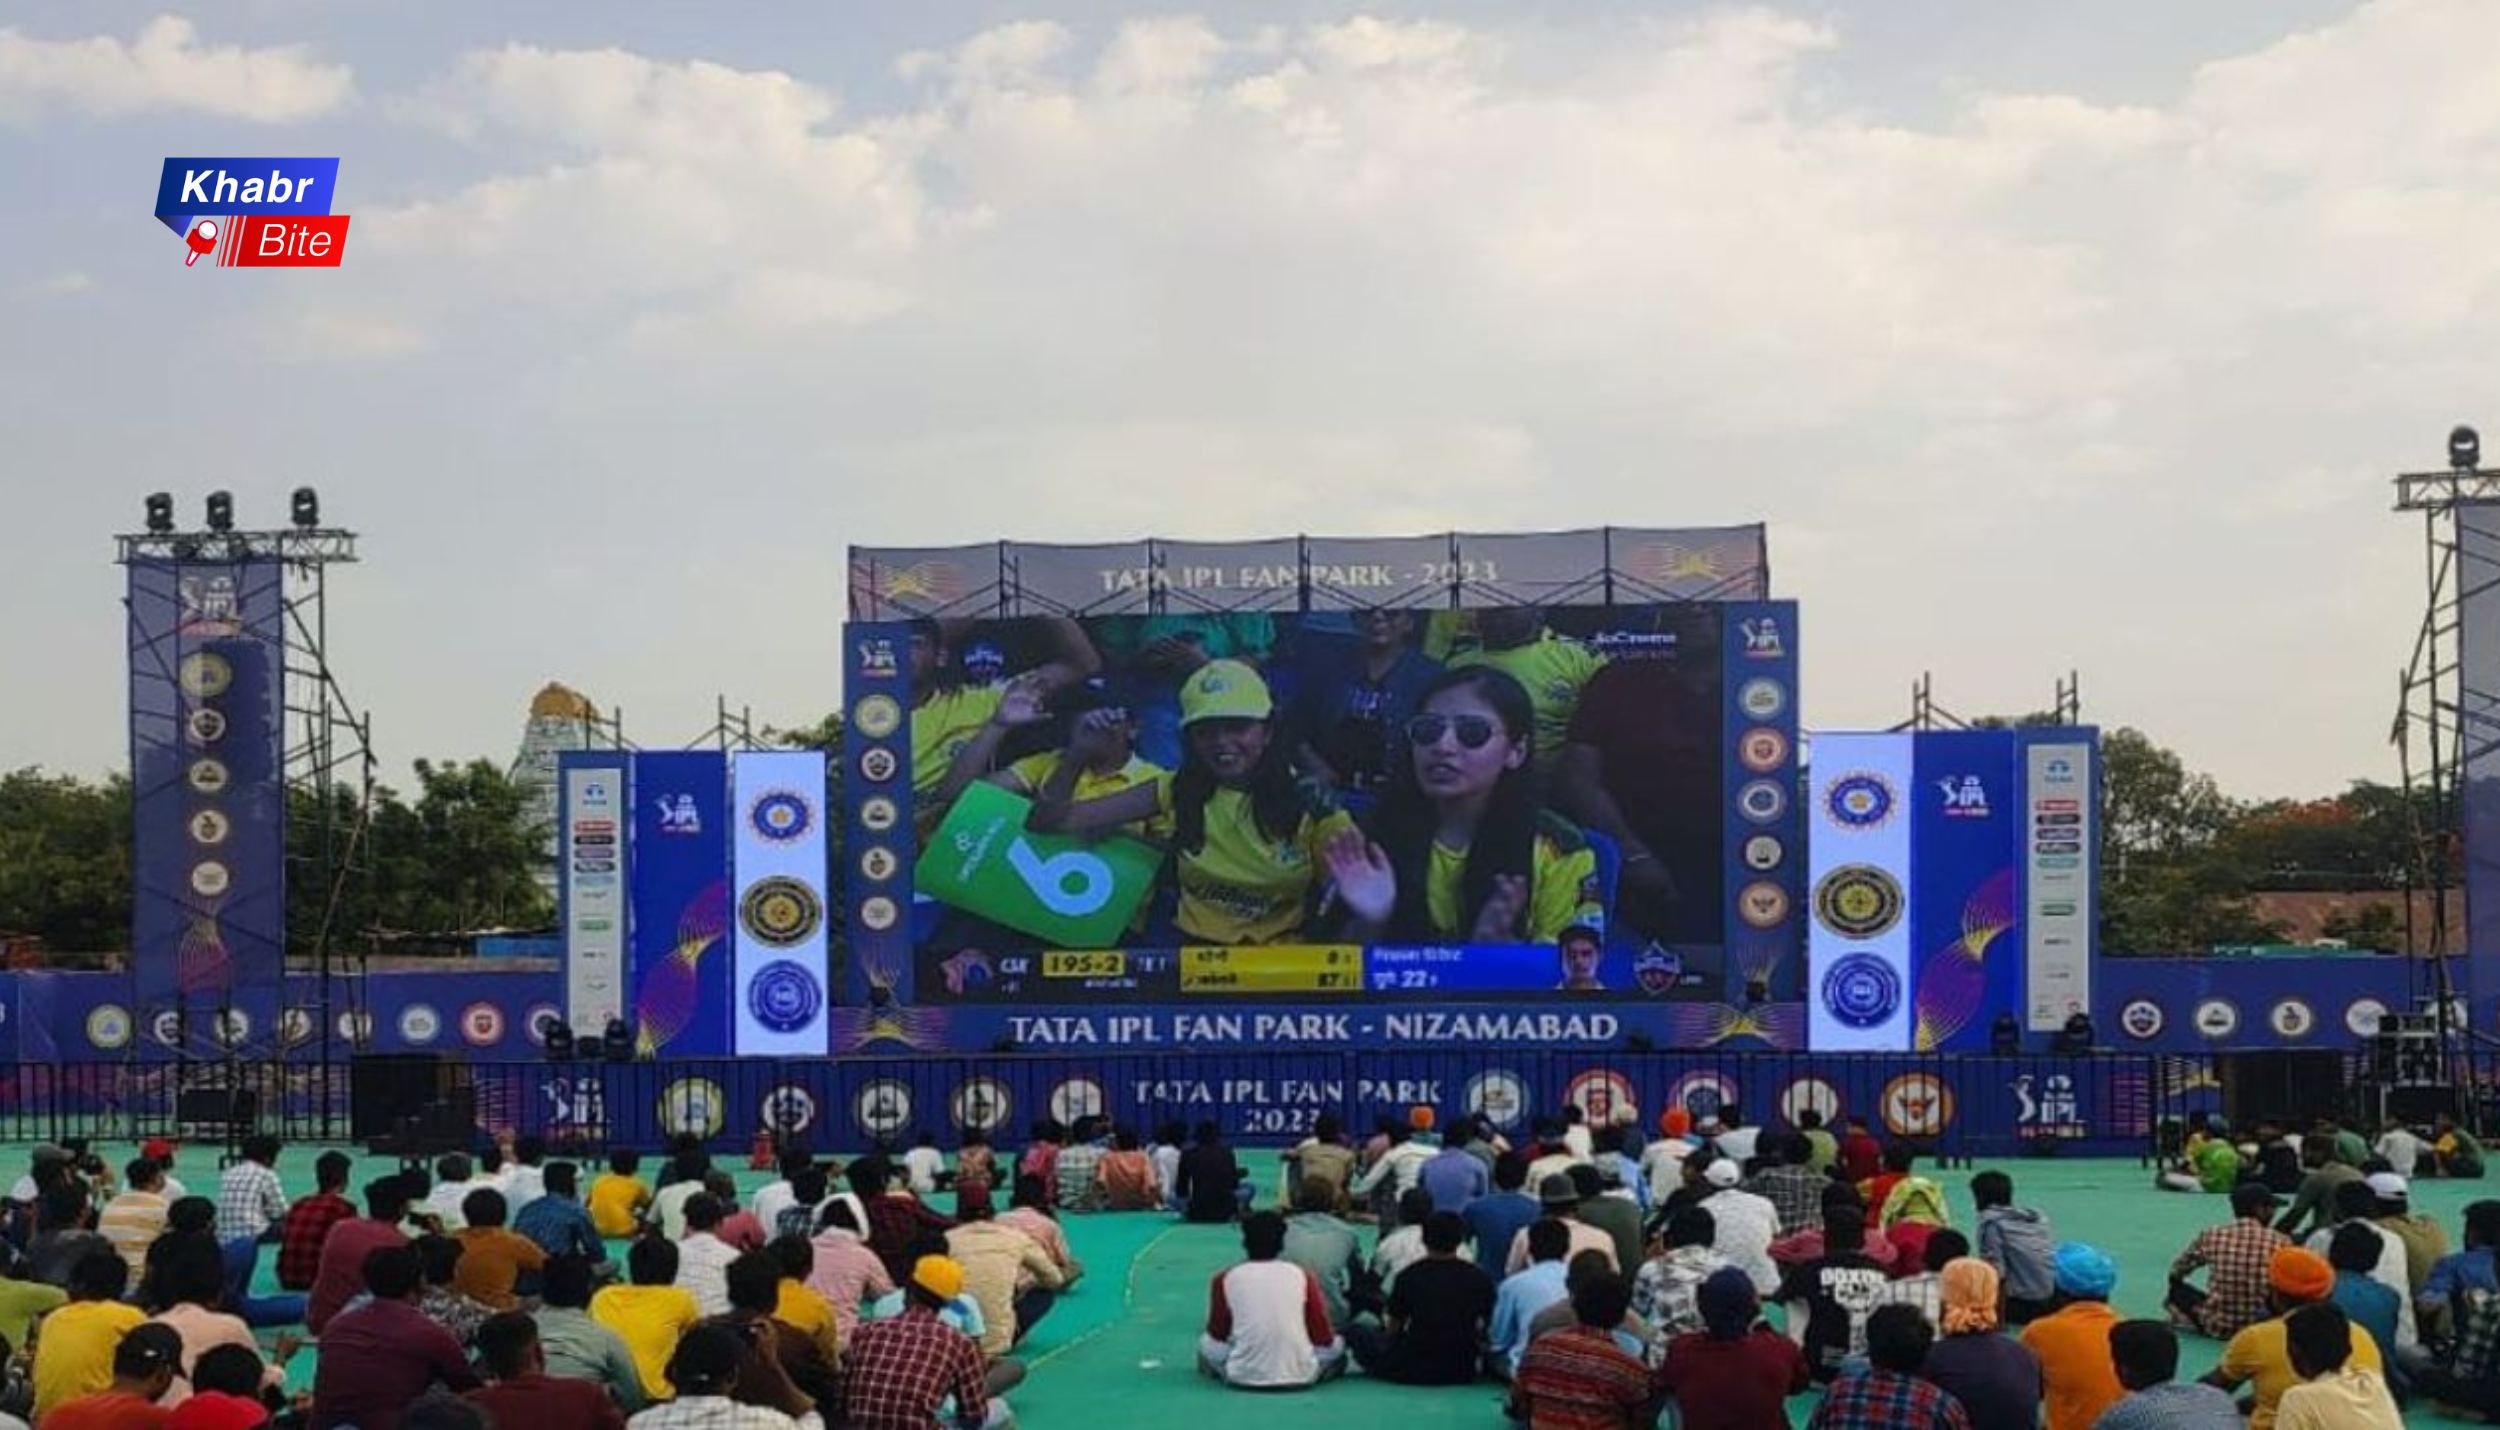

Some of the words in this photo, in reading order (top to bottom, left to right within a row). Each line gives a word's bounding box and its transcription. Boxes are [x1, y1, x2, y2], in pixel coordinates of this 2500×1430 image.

[1101, 566, 1172, 592] TATA
[1240, 565, 1299, 589] FAN
[1309, 564, 1394, 588] PARK
[1419, 561, 1499, 585] 2023
[1007, 836, 1113, 917] 6
[1049, 954, 1121, 973] 195-2
[1008, 1016, 1099, 1043] TATA
[1108, 1015, 1162, 1043] IPL
[1174, 1014, 1243, 1041] FAN
[1254, 1014, 1349, 1041] PARK
[1385, 1013, 1619, 1041] NIZAMABAD
[1133, 1079, 1213, 1104] TATA
[1222, 1079, 1271, 1104] IPL
[1280, 1079, 1343, 1104] FAN
[1356, 1079, 1443, 1104] PARK
